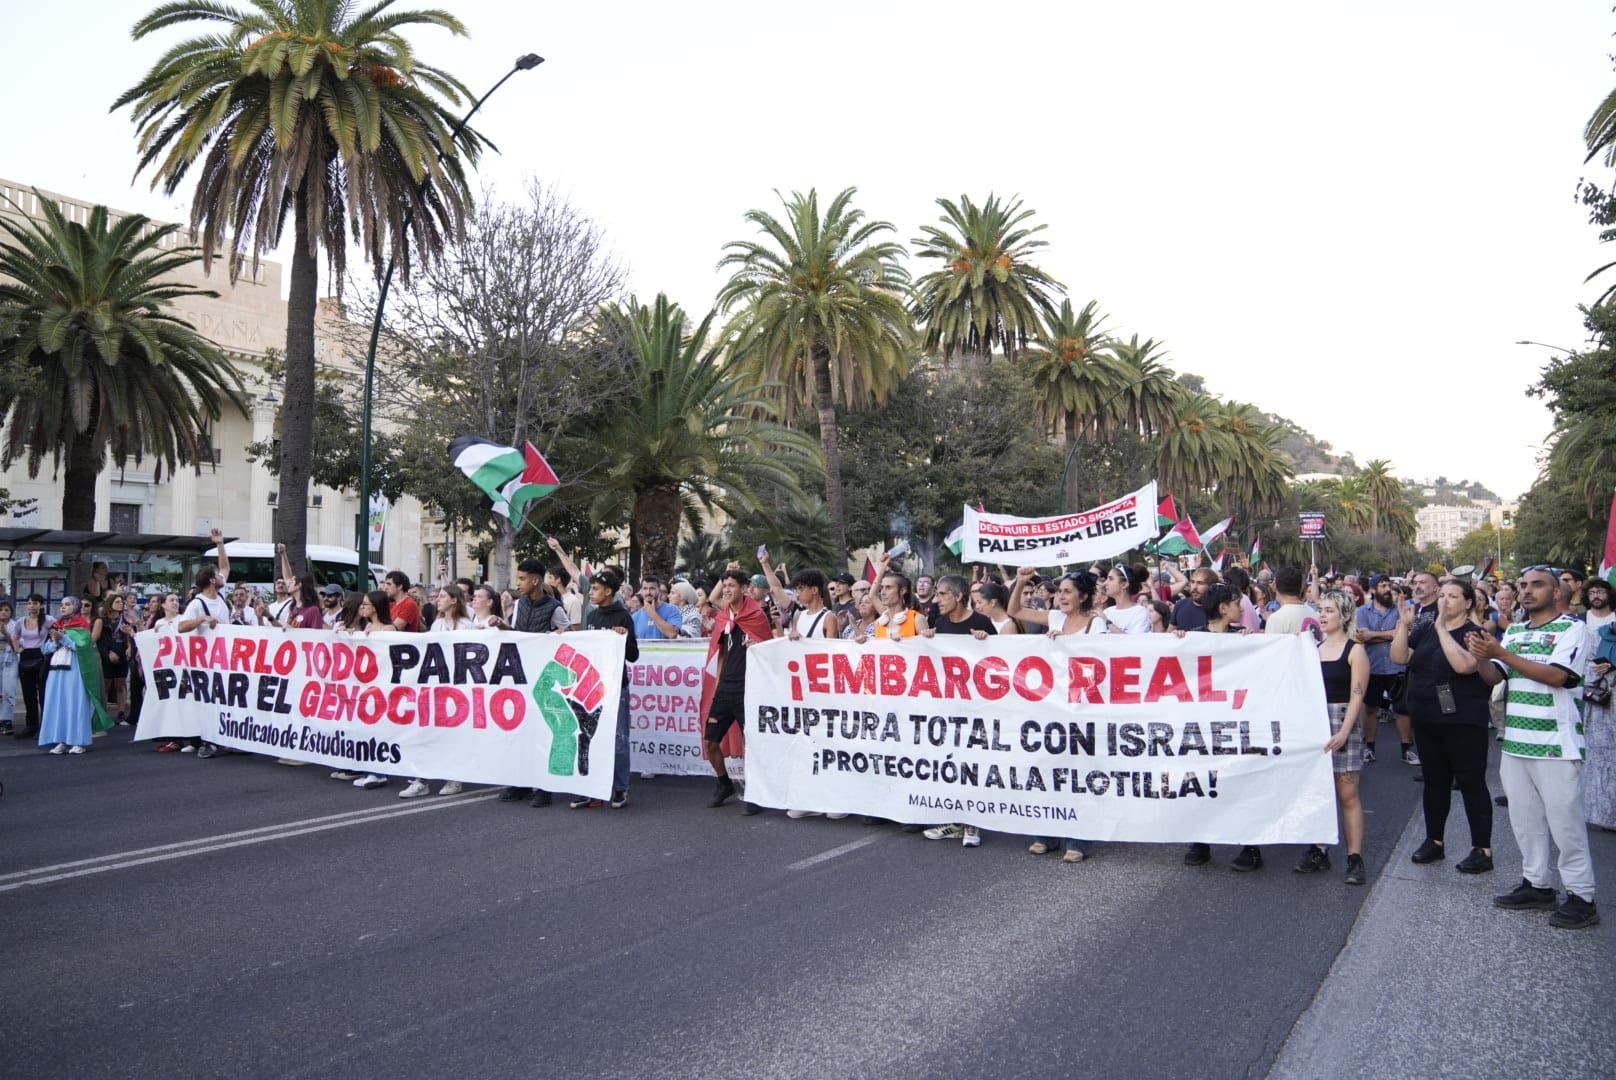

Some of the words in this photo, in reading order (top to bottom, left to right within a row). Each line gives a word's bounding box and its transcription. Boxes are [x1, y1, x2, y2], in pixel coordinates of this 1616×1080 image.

[978, 532, 1083, 553] PALESTINA
[1086, 511, 1138, 539] LIBRE
[979, 521, 1029, 535] DESTRUIR
[1031, 525, 1045, 534] EL
[1046, 516, 1088, 533] ESTADO
[153, 635, 298, 676] PARARLO
[301, 641, 379, 684] TODO
[388, 642, 528, 685] PARA
[787, 652, 1055, 701] ¡EMBARGO
[1067, 655, 1248, 710] REAL,
[152, 668, 250, 709] PARAR
[256, 674, 292, 715] EL
[298, 680, 526, 732] GENOCIDIO
[218, 711, 280, 747] Sindicato
[280, 722, 299, 751] de
[299, 724, 402, 765] Estudiantes
[757, 704, 902, 742] RUPTURA
[908, 714, 1012, 752] TOTAL
[1019, 719, 1096, 757] CON
[1106, 720, 1283, 758] ISRAEL!
[811, 748, 980, 787] ¡PROTECCIÓN
[984, 764, 1006, 789] A
[1008, 766, 1048, 792] LA
[1051, 767, 1219, 800] FLOTILLA!
[907, 793, 964, 812] MALAGA
[967, 800, 996, 814] POR
[999, 802, 1078, 822] PALESTINA
